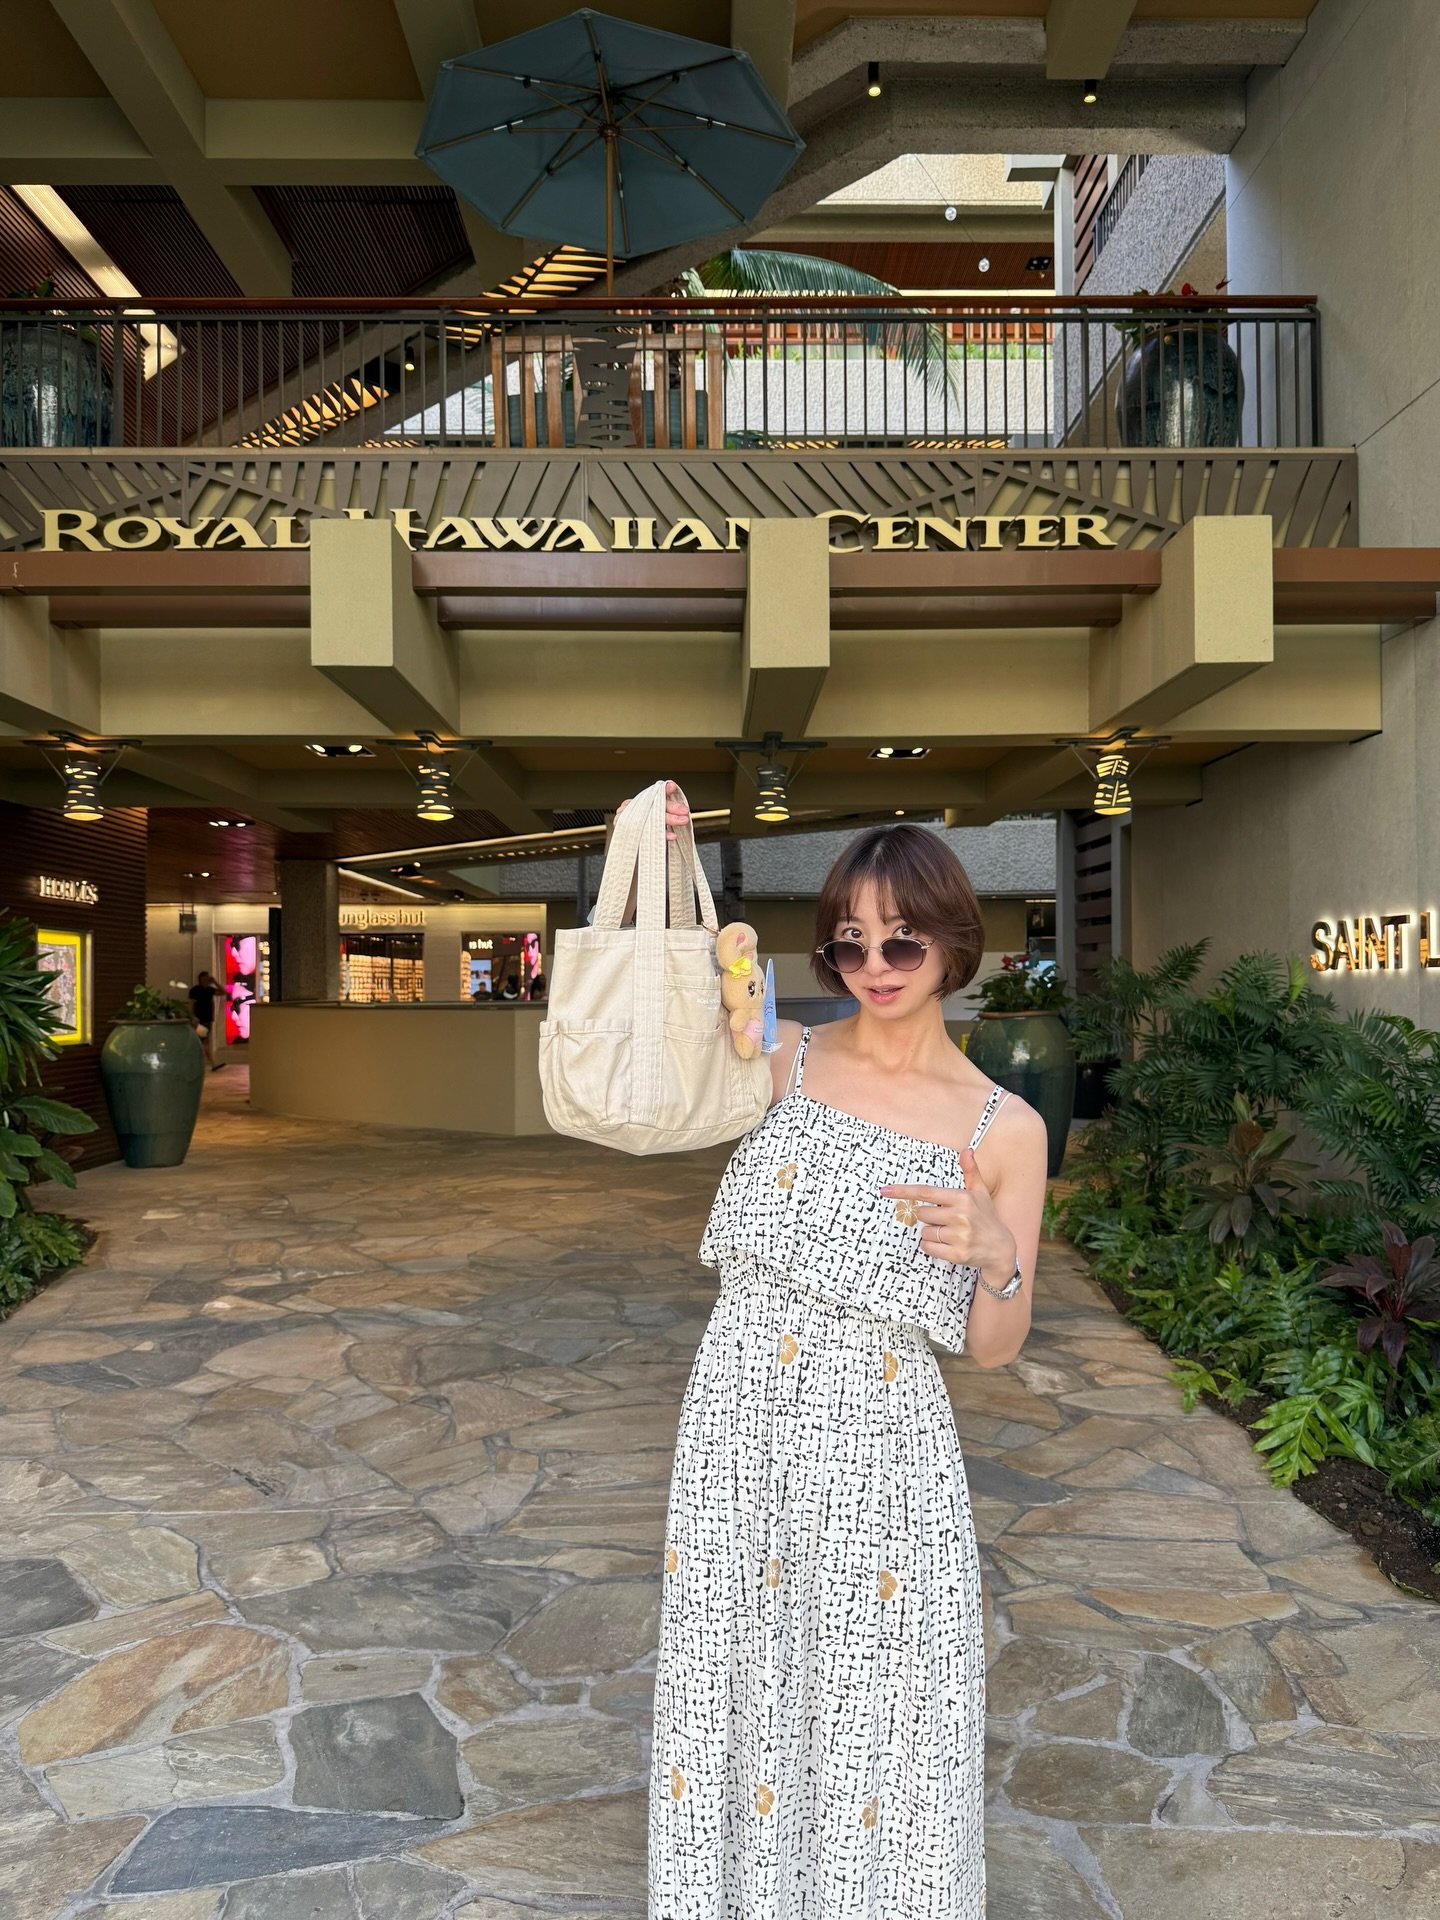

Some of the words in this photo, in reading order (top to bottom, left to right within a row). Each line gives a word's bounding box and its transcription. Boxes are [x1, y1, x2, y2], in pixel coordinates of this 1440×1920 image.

[39, 508, 310, 551] ROYAL
[815, 509, 1118, 553] CENTER
[399, 908, 425, 926] hut
[1310, 915, 1410, 971] SAINT
